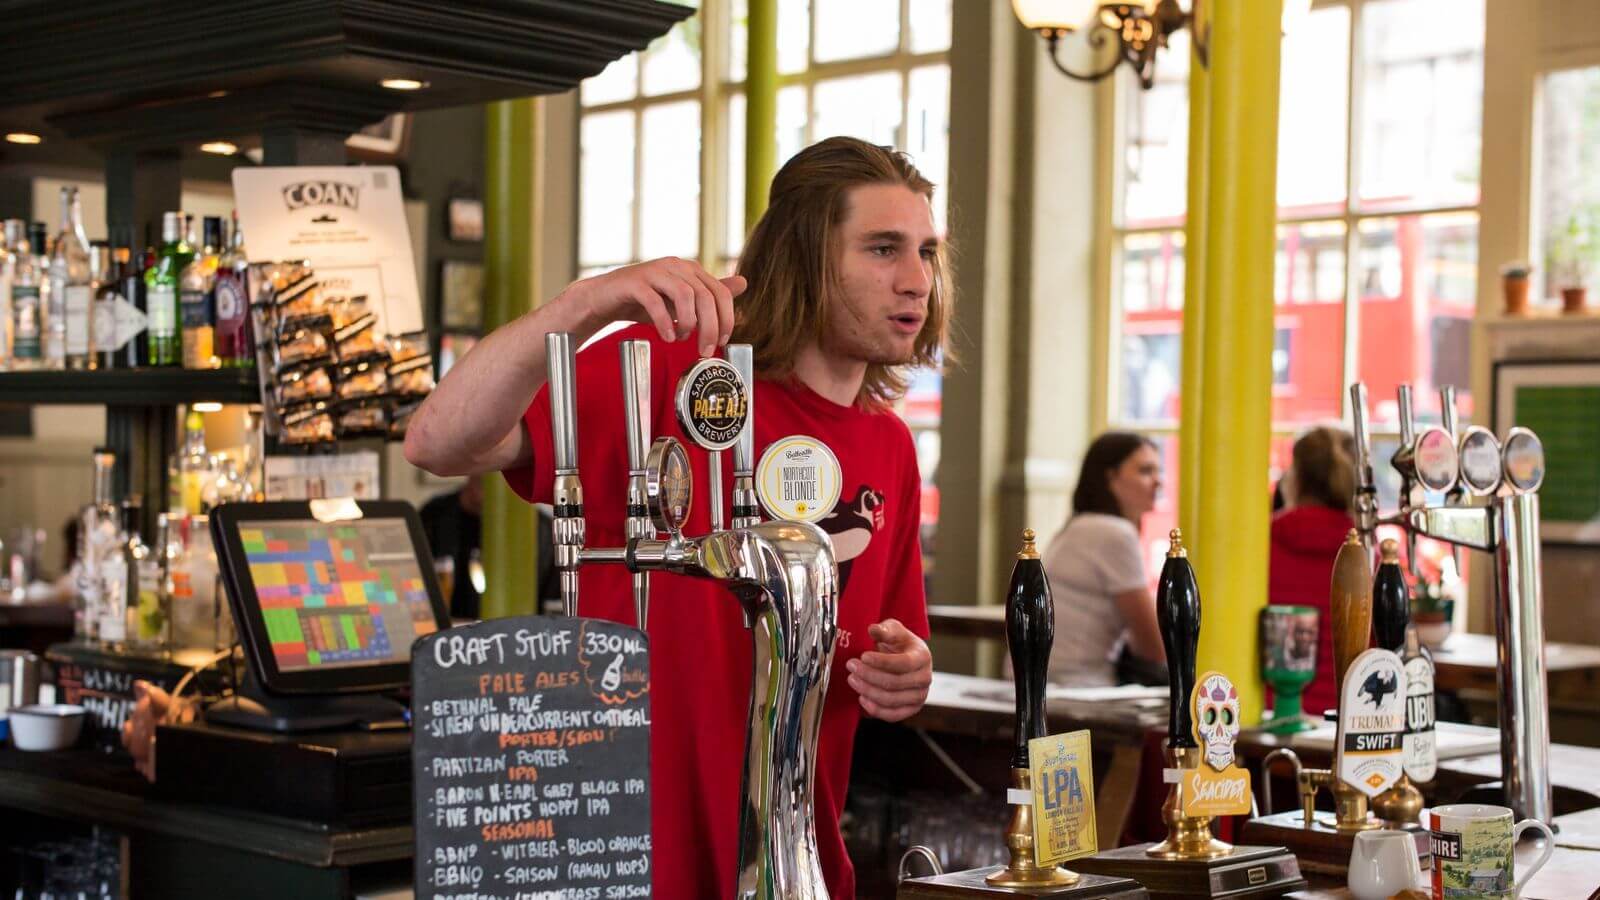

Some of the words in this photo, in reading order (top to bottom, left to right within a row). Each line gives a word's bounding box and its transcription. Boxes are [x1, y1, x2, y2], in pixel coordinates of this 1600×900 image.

[286, 180, 358, 211] COAN
[694, 398, 724, 418] PALE
[725, 396, 746, 418] ALE
[697, 420, 744, 441] BREWERY
[783, 466, 816, 481] NORTHCOTE
[783, 480, 817, 501] BLONDE
[434, 632, 508, 668] CRAFT
[514, 628, 572, 661] STUFF
[479, 671, 527, 696] PALE
[535, 671, 580, 689] ALES
[508, 694, 543, 714] PALE
[1356, 733, 1398, 751] SWIFT
[432, 753, 507, 778] PARTIZAN
[515, 748, 570, 768] PORTER
[508, 765, 538, 783] IPA
[543, 782, 575, 799] GREY
[581, 779, 620, 796] BLACK
[624, 778, 646, 795] IPA
[1042, 766, 1083, 810] LPA
[1189, 774, 1246, 805] SEACIDER
[435, 807, 468, 829] FIVE
[474, 802, 532, 827] POINTS
[539, 797, 579, 818] HOPPY
[586, 797, 610, 818] IPA
[481, 818, 556, 842] SEASONAL
[566, 836, 606, 856] BLOOD
[608, 833, 653, 853] ORANGE
[503, 864, 559, 883] SAISON
